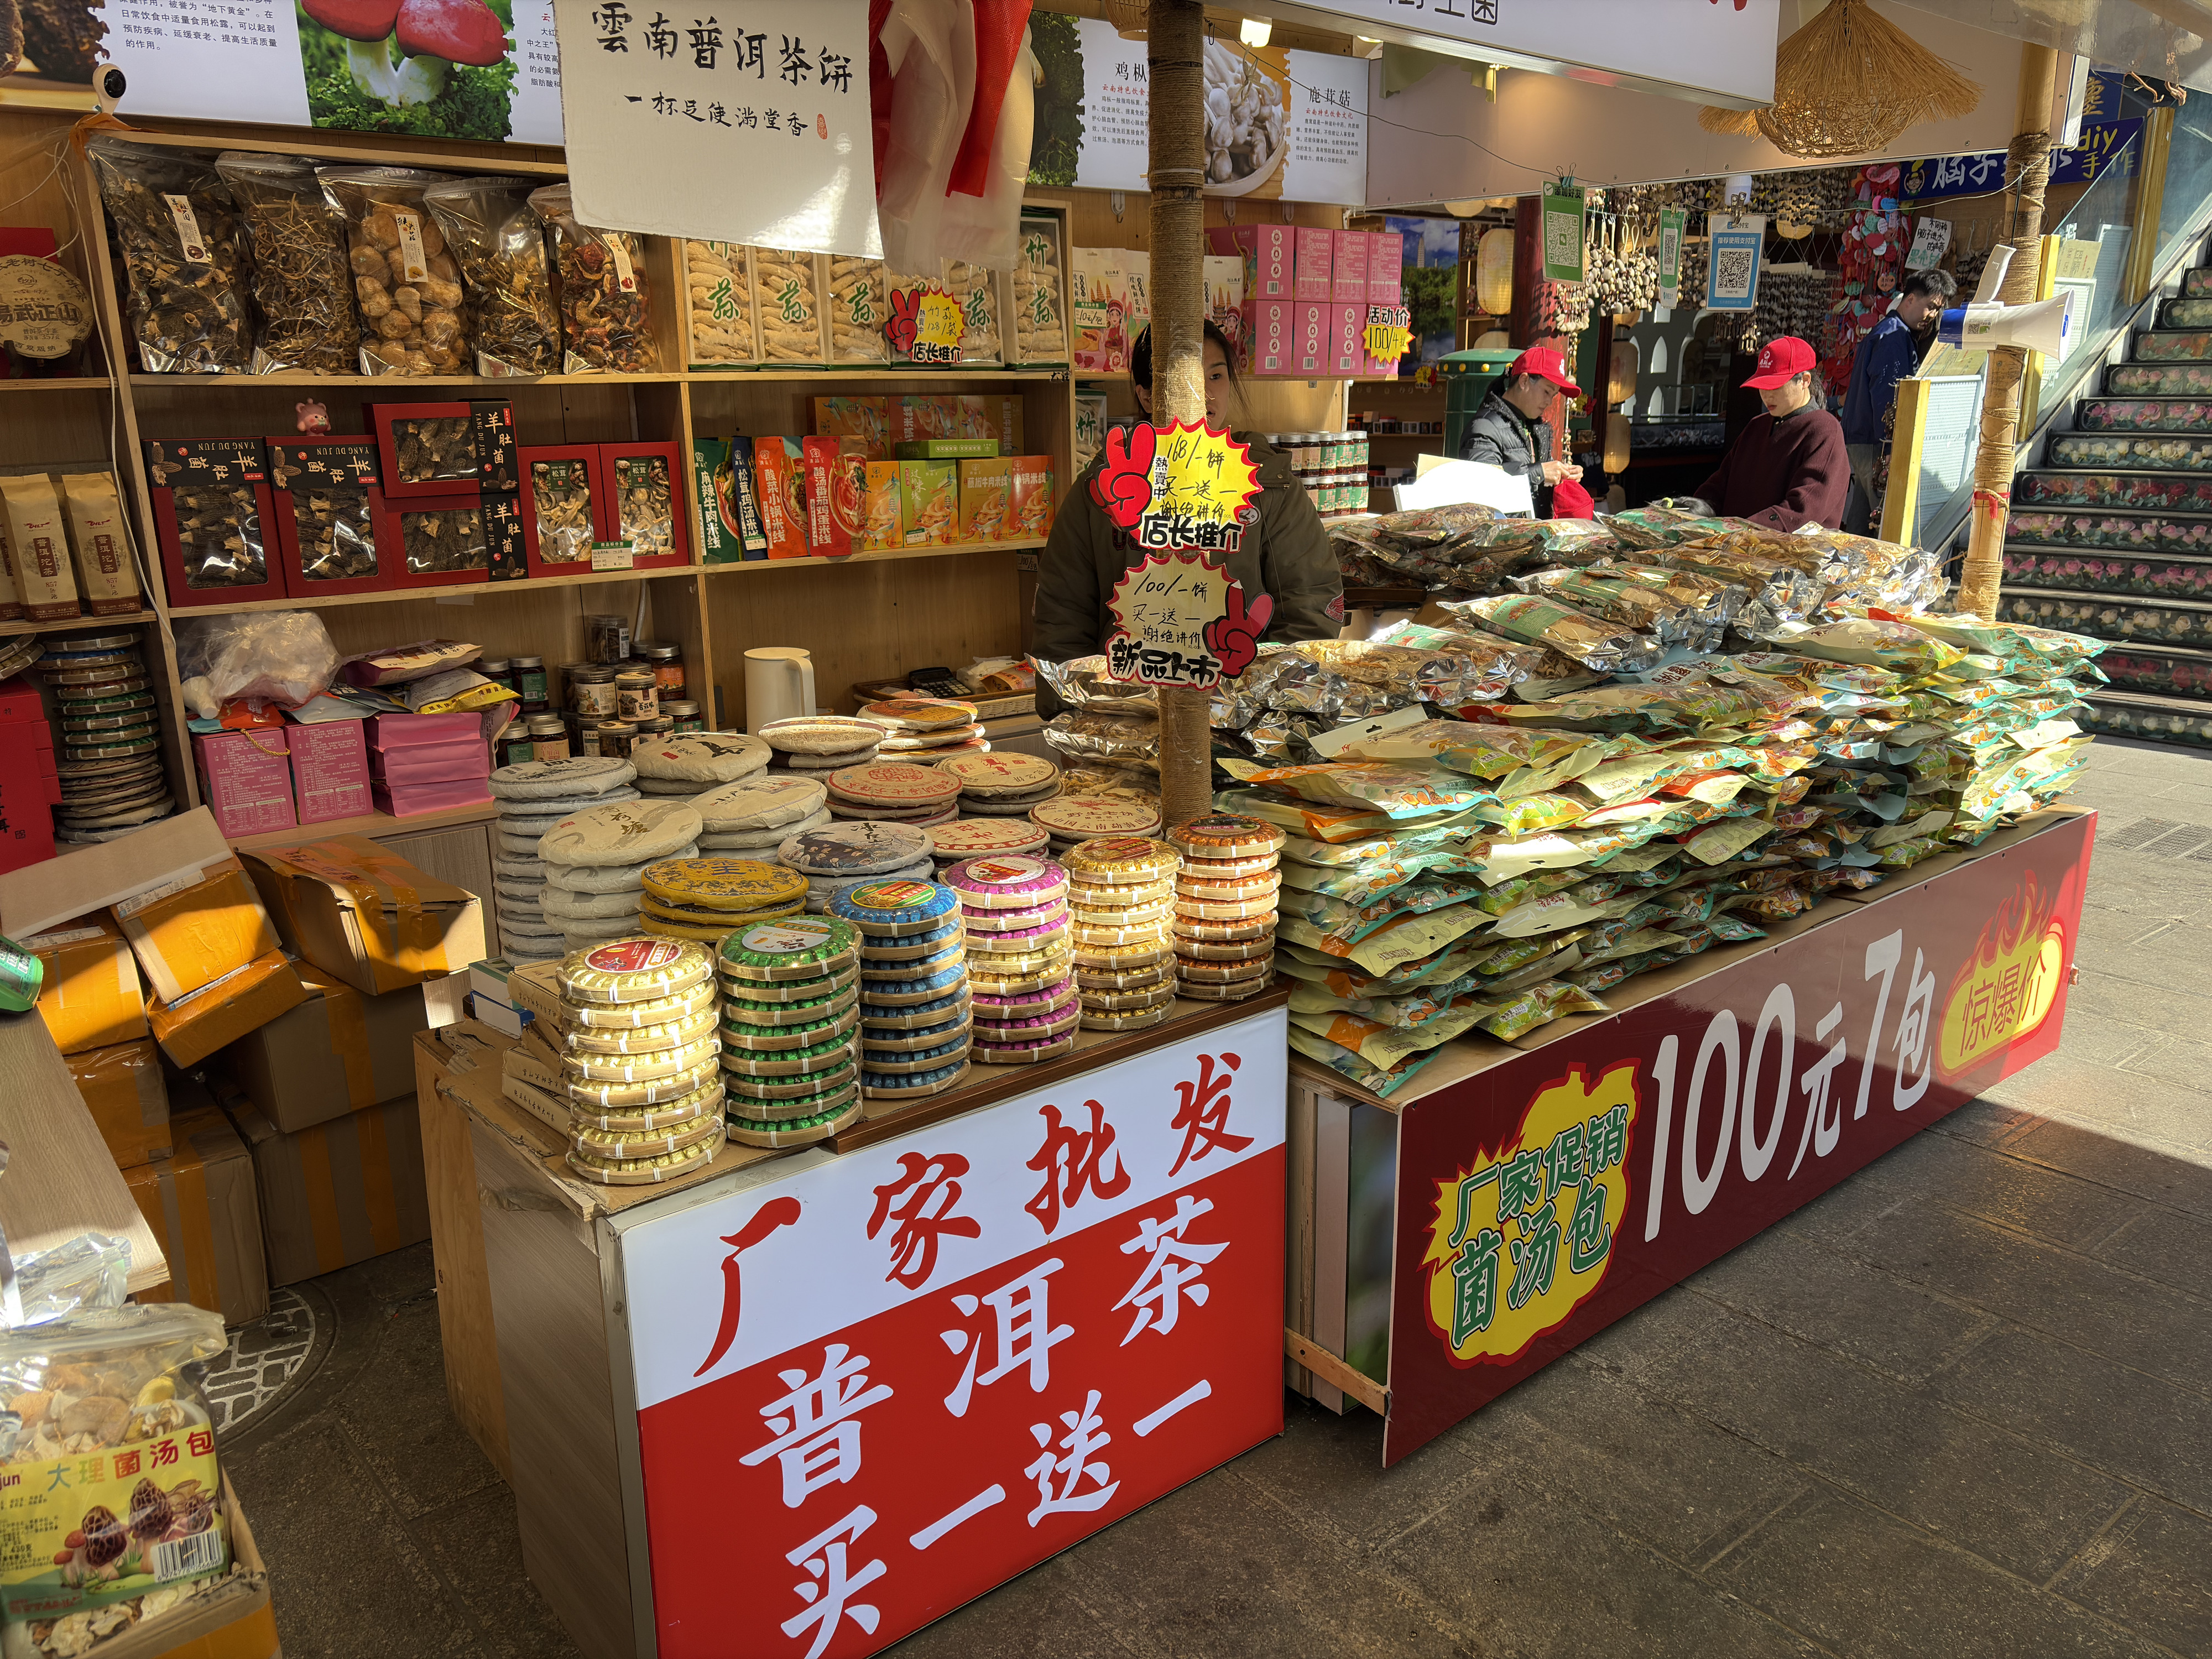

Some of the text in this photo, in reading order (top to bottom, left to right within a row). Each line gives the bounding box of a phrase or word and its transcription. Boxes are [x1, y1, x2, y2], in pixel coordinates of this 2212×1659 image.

[121, 9, 275, 33] 日常饮食中适量食用松露，可以起到
[123, 24, 278, 48] 预防疾病、延缓衰老、提高生活质量
[126, 39, 161, 51] 的作用。
[1102, 84, 1149, 96] 云南特色饮食
[1932, 147, 2073, 189] 脑子水
[1368, 305, 1411, 328] 活动价
[914, 341, 961, 362] 店长推介
[477, 432, 484, 441] DU
[487, 523, 494, 531] DU
[1141, 513, 1242, 551] 店长推介
[1112, 637, 1218, 686] 新品上市
[1961, 954, 2046, 1058] 惊爆价
[1449, 1104, 1628, 1249] 厂家促销
[693, 1052, 1256, 1377] 厂家批发
[1451, 1179, 1611, 1350] 菌汤包
[739, 1196, 1231, 1508] 普洱茶
[47, 1429, 215, 1493] 大理菌汤包
[781, 1379, 1212, 1659] 买一送一
